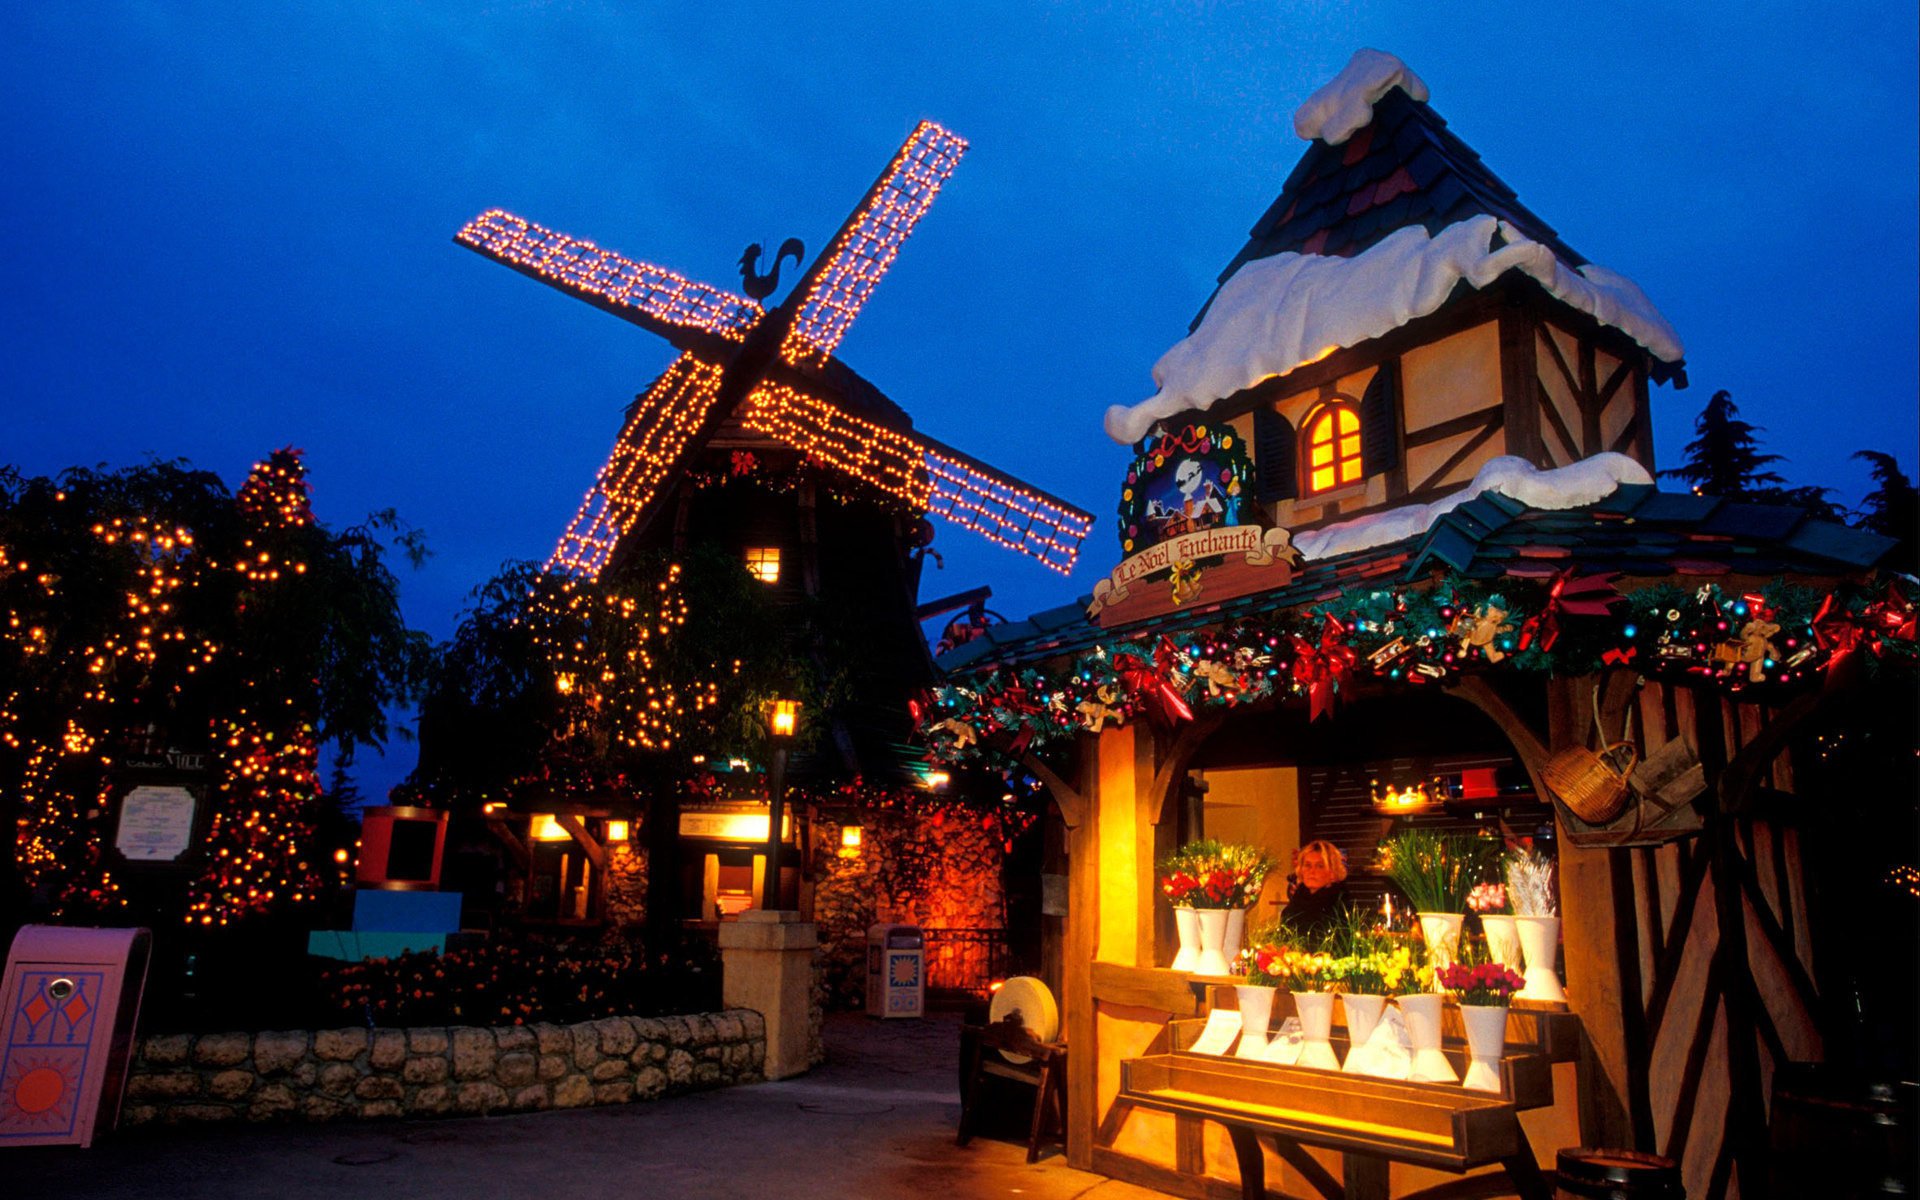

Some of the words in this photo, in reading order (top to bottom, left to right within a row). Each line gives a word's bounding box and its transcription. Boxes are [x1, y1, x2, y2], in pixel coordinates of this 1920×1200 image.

[1114, 563, 1136, 585] Le
[1137, 543, 1170, 574] Noël
[1177, 529, 1257, 559] Enchanté
